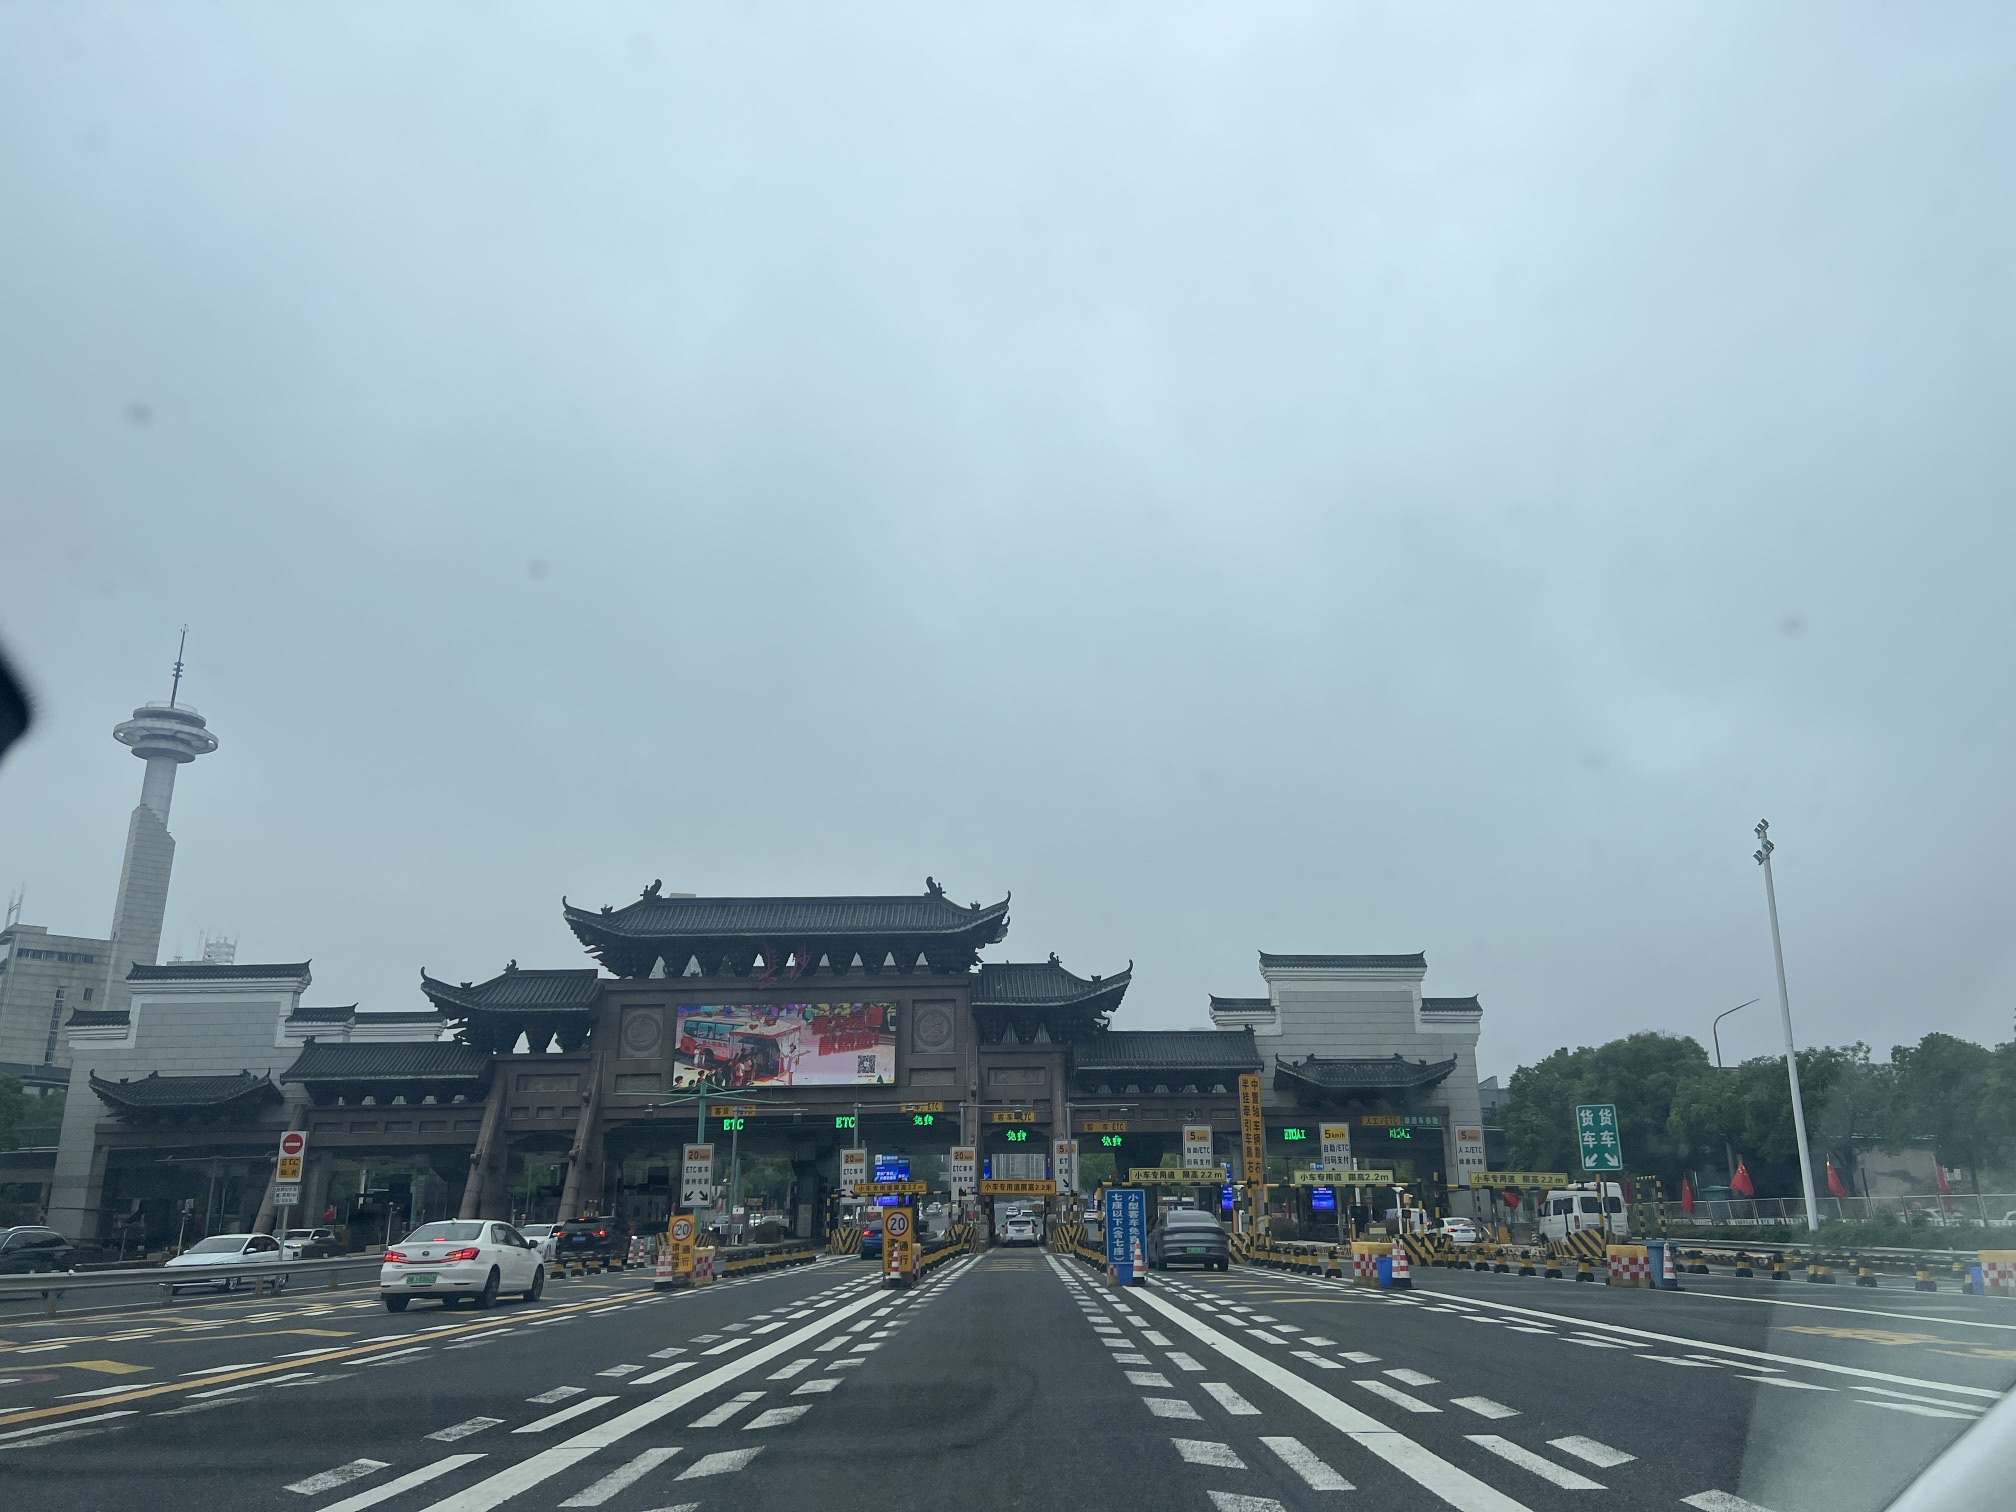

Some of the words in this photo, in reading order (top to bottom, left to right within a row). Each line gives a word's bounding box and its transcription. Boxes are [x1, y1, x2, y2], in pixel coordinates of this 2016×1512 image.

[724, 1119, 744, 1130] ETC
[836, 1117, 856, 1128] ETC
[1242, 1079, 1253, 1174] 半挂牵引车靠右
[1251, 1079, 1260, 1174] 中置轴车辆靠右
[1599, 1109, 1616, 1147] 货车
[1325, 1130, 1331, 1138] 5
[1580, 1109, 1597, 1148] 货车
[1191, 1132, 1195, 1140] 5
[1324, 1144, 1349, 1152] 自助/ETC
[689, 1151, 698, 1159] 20
[1325, 1156, 1349, 1164] 扫码支付
[1135, 1171, 1175, 1179] 小车专用道
[1475, 1175, 1515, 1183] 小车专用道
[676, 1224, 689, 1235] 20
[891, 1218, 905, 1230] 20
